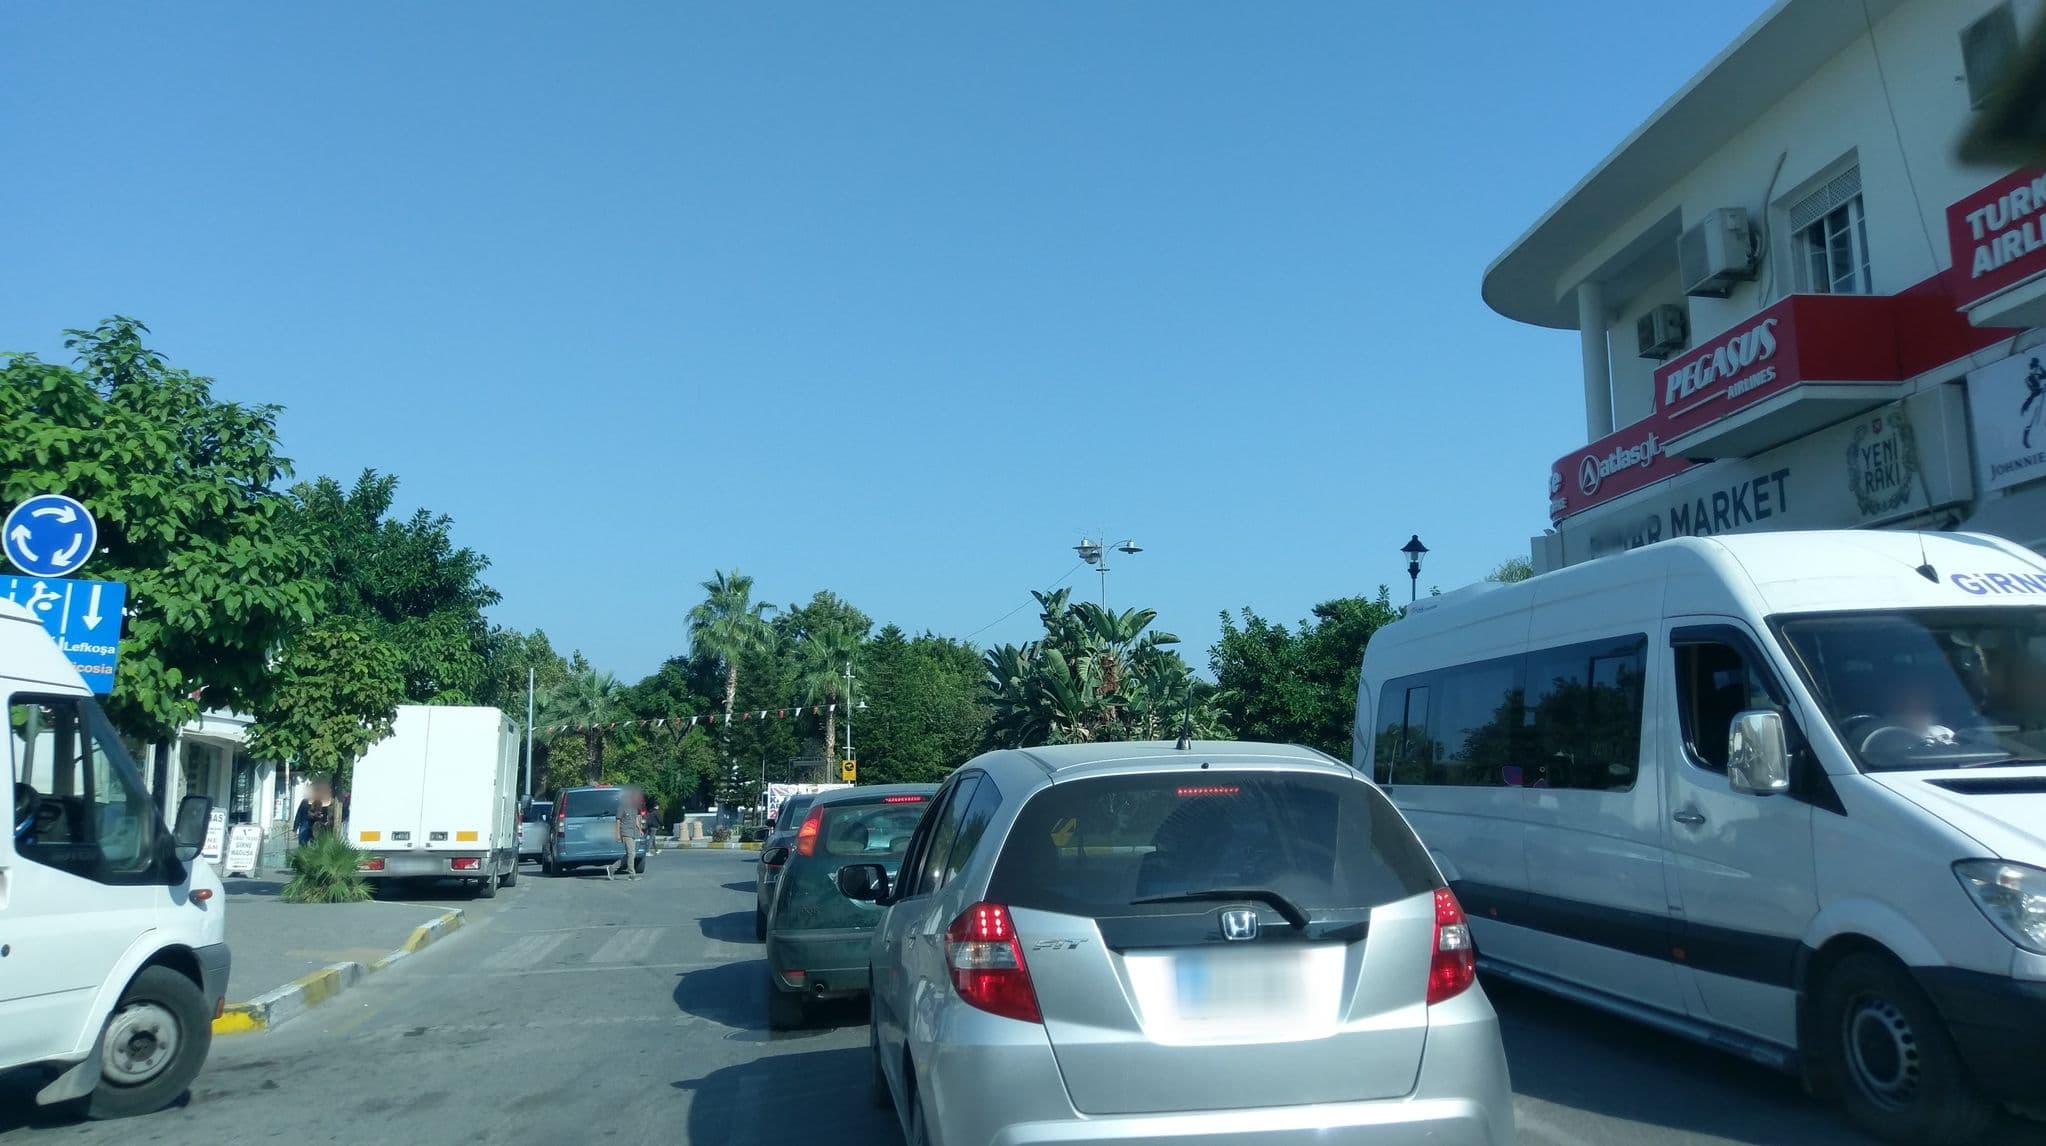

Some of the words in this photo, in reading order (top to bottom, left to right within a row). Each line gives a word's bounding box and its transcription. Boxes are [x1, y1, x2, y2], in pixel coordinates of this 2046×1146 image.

[1665, 318, 1778, 405] PEGASUS
[1727, 366, 1777, 400] AIRLINES
[1670, 467, 1791, 538] MARKET
[63, 640, 116, 656] Lefkoşa
[71, 661, 113, 675] icosia
[1032, 936, 1089, 952] FIT
